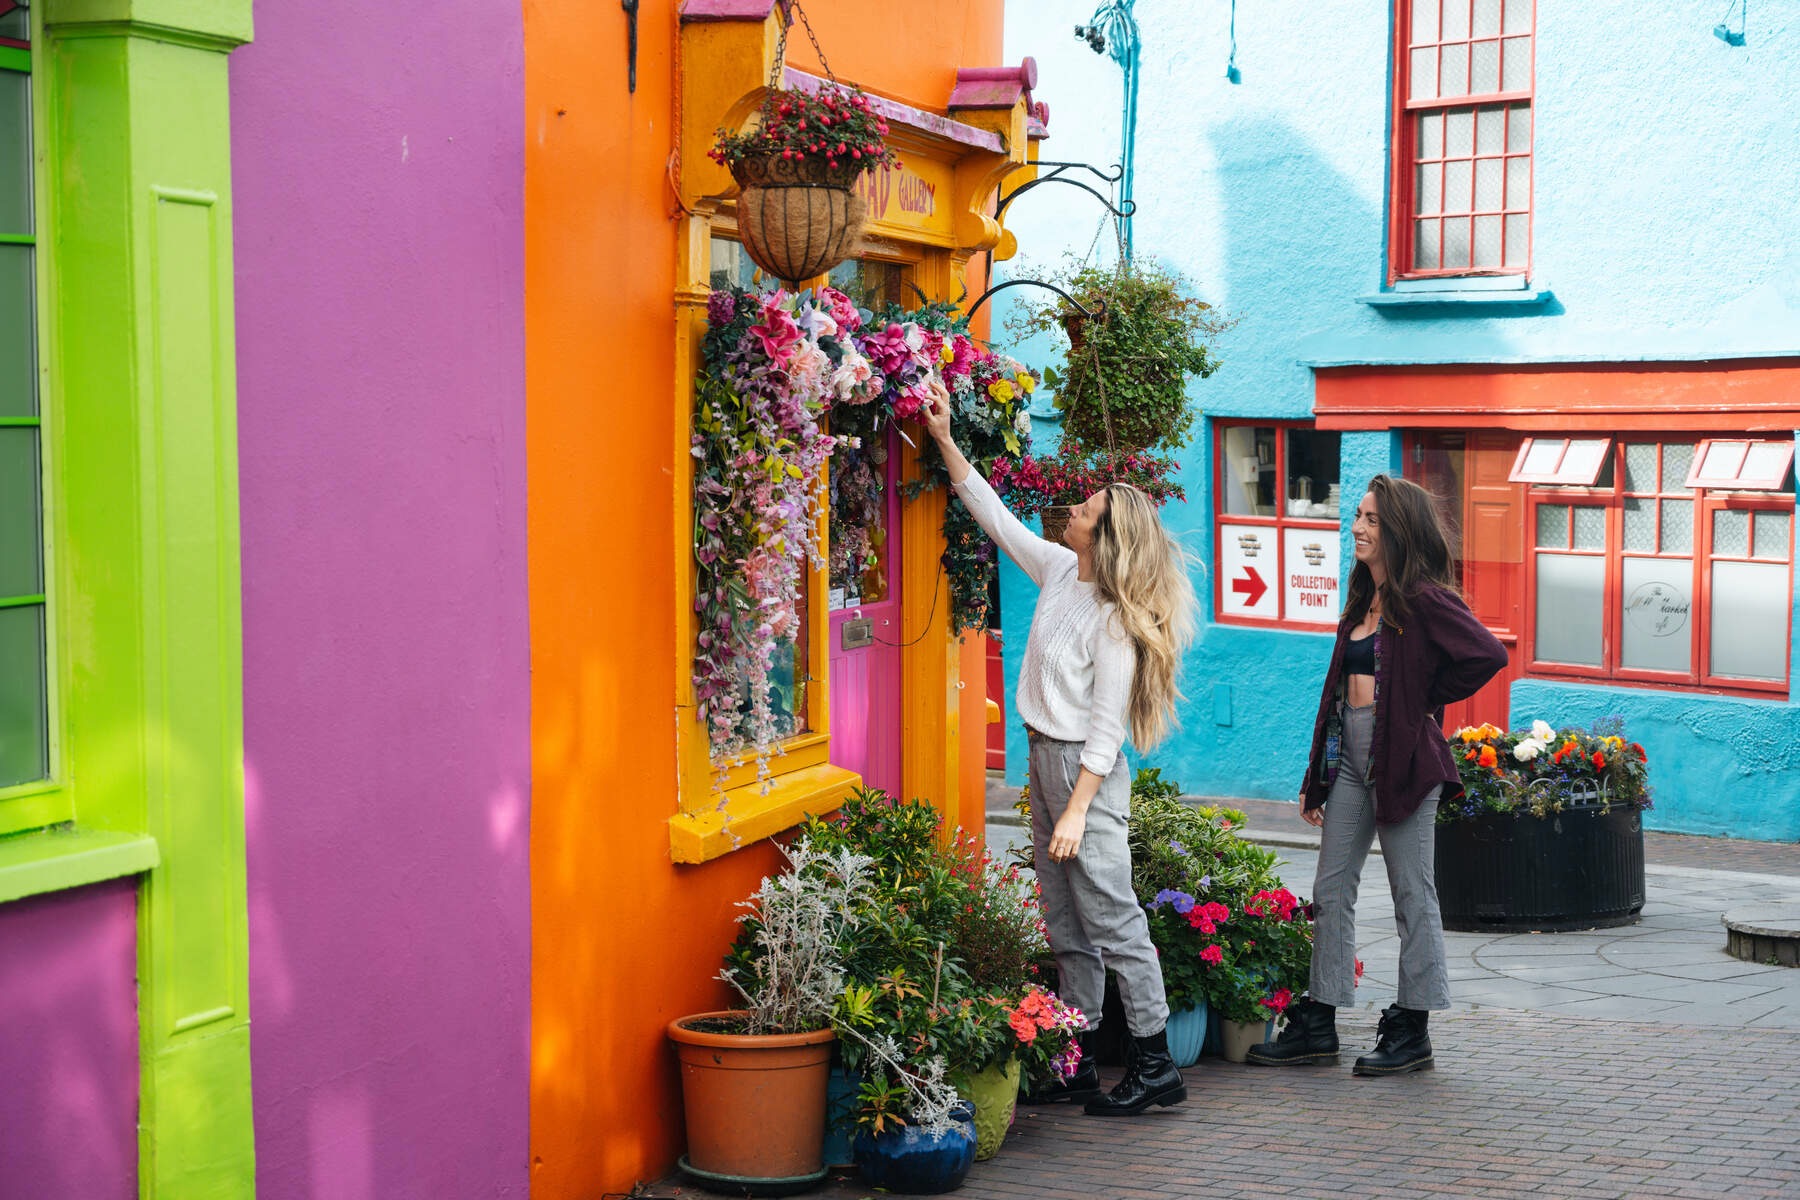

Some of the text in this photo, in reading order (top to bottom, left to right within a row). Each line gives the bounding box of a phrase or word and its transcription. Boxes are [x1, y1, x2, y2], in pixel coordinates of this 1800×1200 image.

[898, 174, 936, 216] GALLERY
[1291, 574, 1338, 591] COLLECTION
[1300, 592, 1328, 607] POINT
